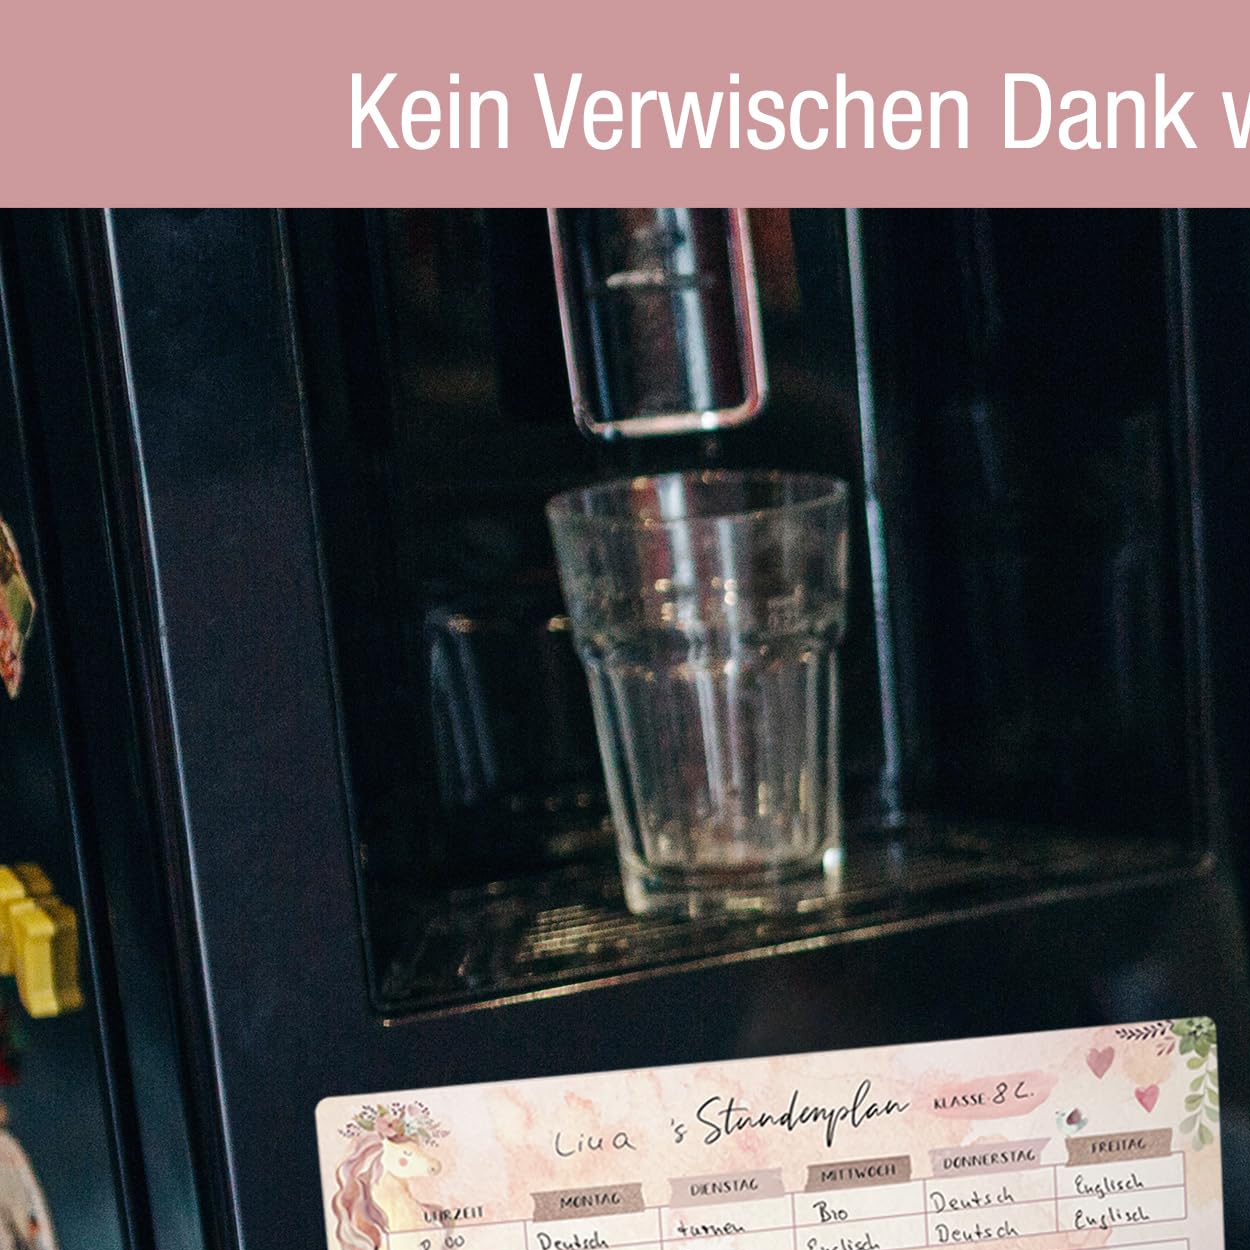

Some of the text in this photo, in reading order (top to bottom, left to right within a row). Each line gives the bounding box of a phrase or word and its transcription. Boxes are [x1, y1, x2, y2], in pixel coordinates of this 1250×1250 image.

[992, 1082, 1008, 1104] 8
[696, 1079, 911, 1148] Stundenplan
[1091, 1138, 1147, 1153] FREITAG
[943, 1149, 1036, 1169] DONNERSTAG
[821, 1164, 896, 1182] MITTWOCH
[690, 1178, 759, 1196] DIENSTAG
[1074, 1173, 1145, 1198] Englisch
[559, 1194, 621, 1209] MONTAG
[929, 1187, 1015, 1213] Deutsch
[423, 1206, 484, 1222] UHRZEIT
[812, 1201, 849, 1223] Bio
[1074, 1206, 1151, 1230] Englisch
[536, 1231, 609, 1250] Deutsch
[934, 1221, 1019, 1243] Deutsch
